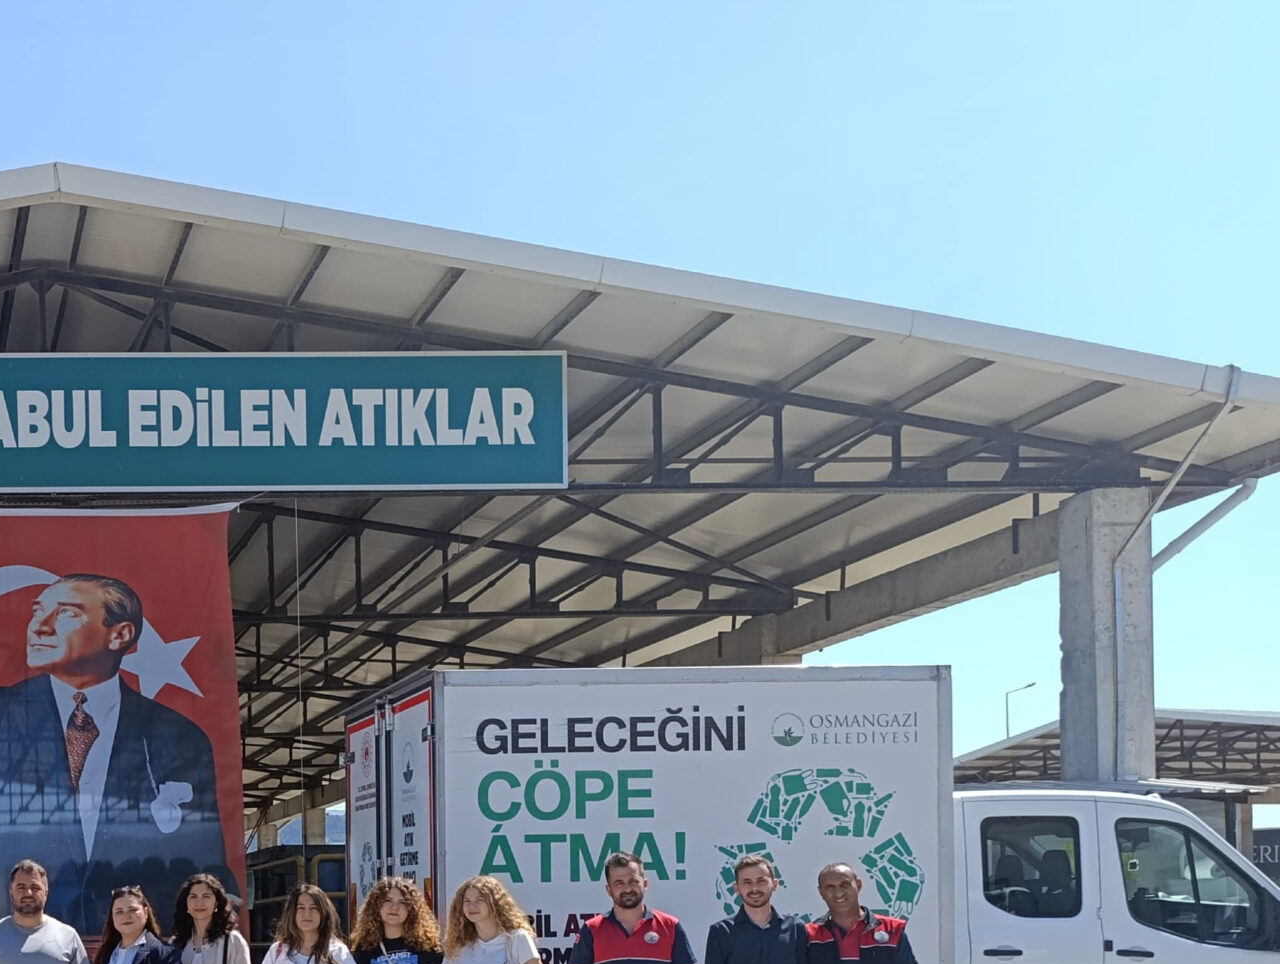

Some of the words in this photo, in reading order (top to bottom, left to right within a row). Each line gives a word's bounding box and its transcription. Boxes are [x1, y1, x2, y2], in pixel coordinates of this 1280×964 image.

[319, 387, 536, 446] ATIKLAR
[476, 705, 746, 754] GELECEĞİNİ
[810, 711, 919, 729] OSMANGAZİ
[811, 731, 919, 745] BELEDİYESİ
